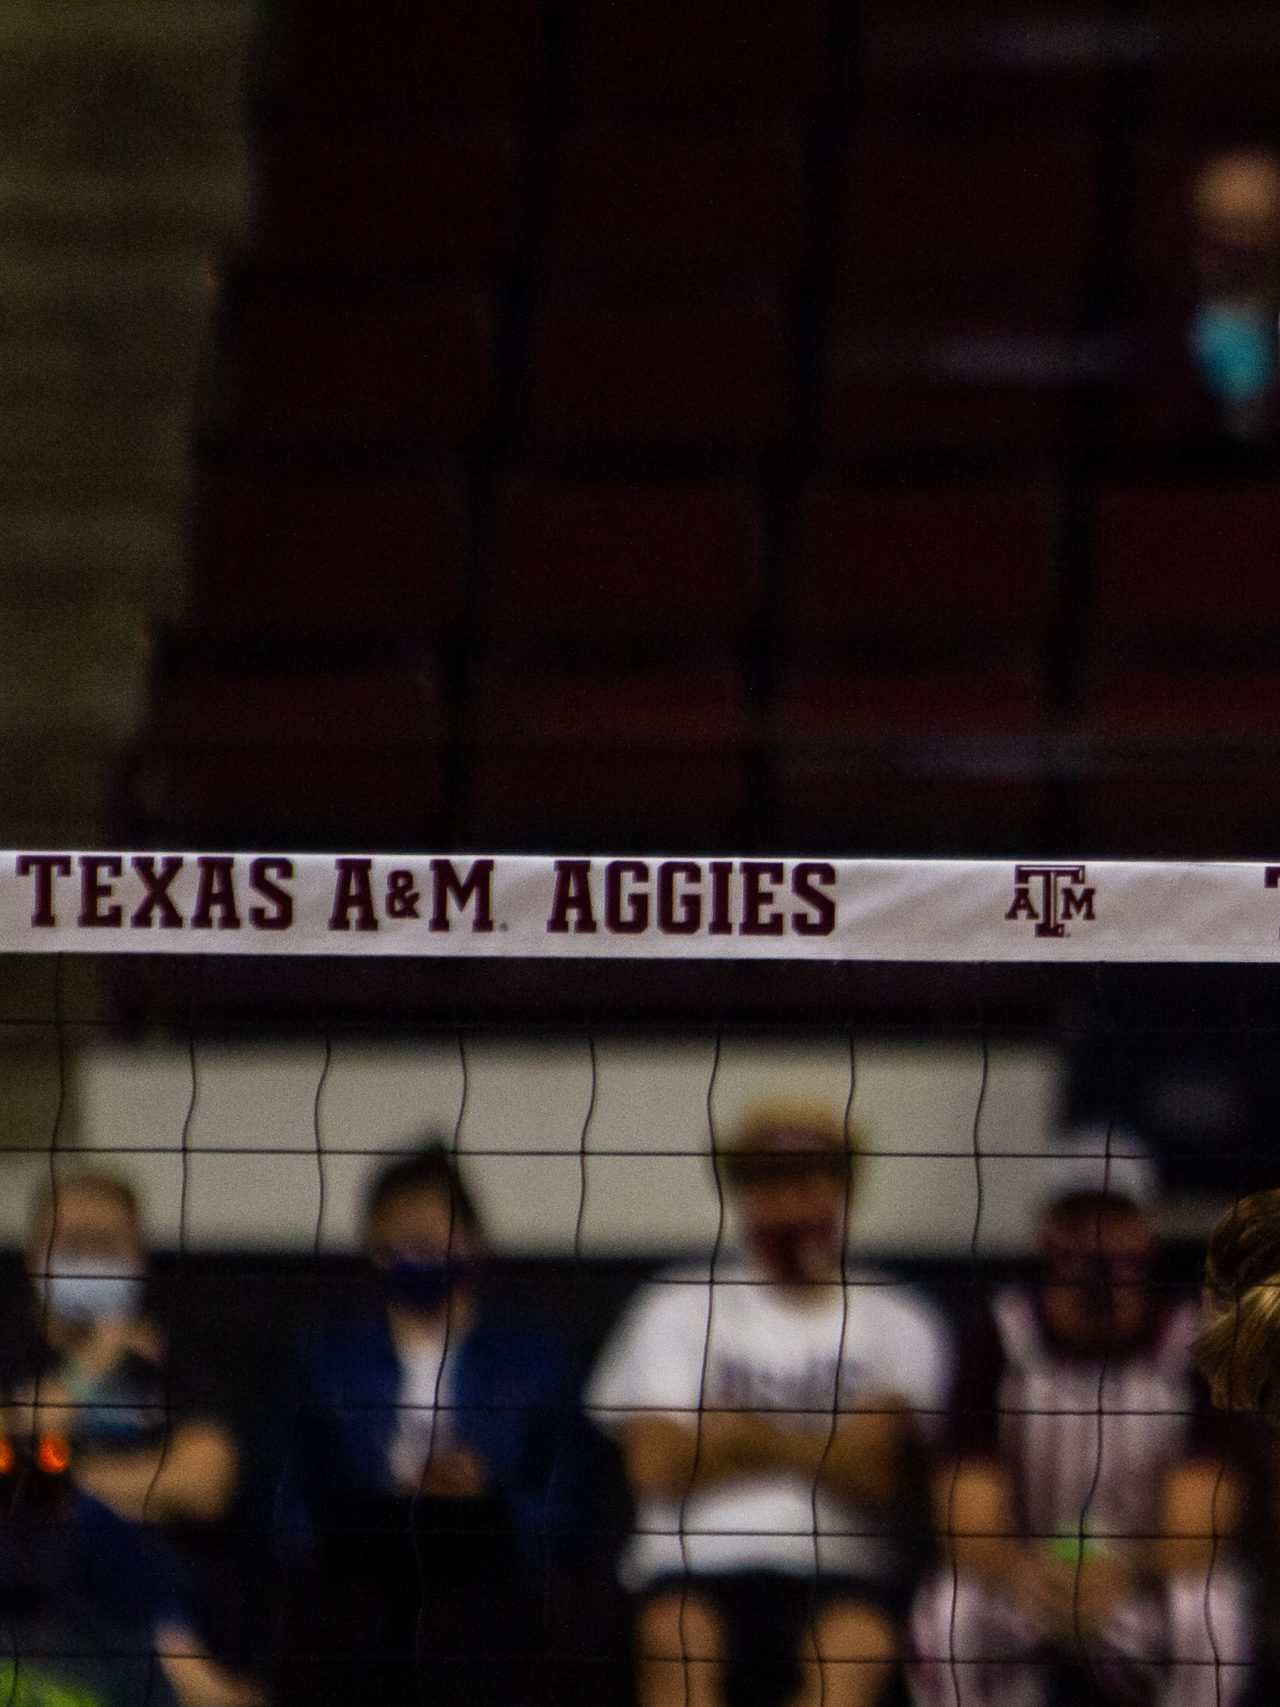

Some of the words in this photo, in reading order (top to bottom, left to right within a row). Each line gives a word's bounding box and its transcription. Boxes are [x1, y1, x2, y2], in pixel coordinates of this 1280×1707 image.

[15, 854, 295, 931] TEXAS
[328, 858, 496, 934] A&M
[546, 860, 838, 936] AGGIES
